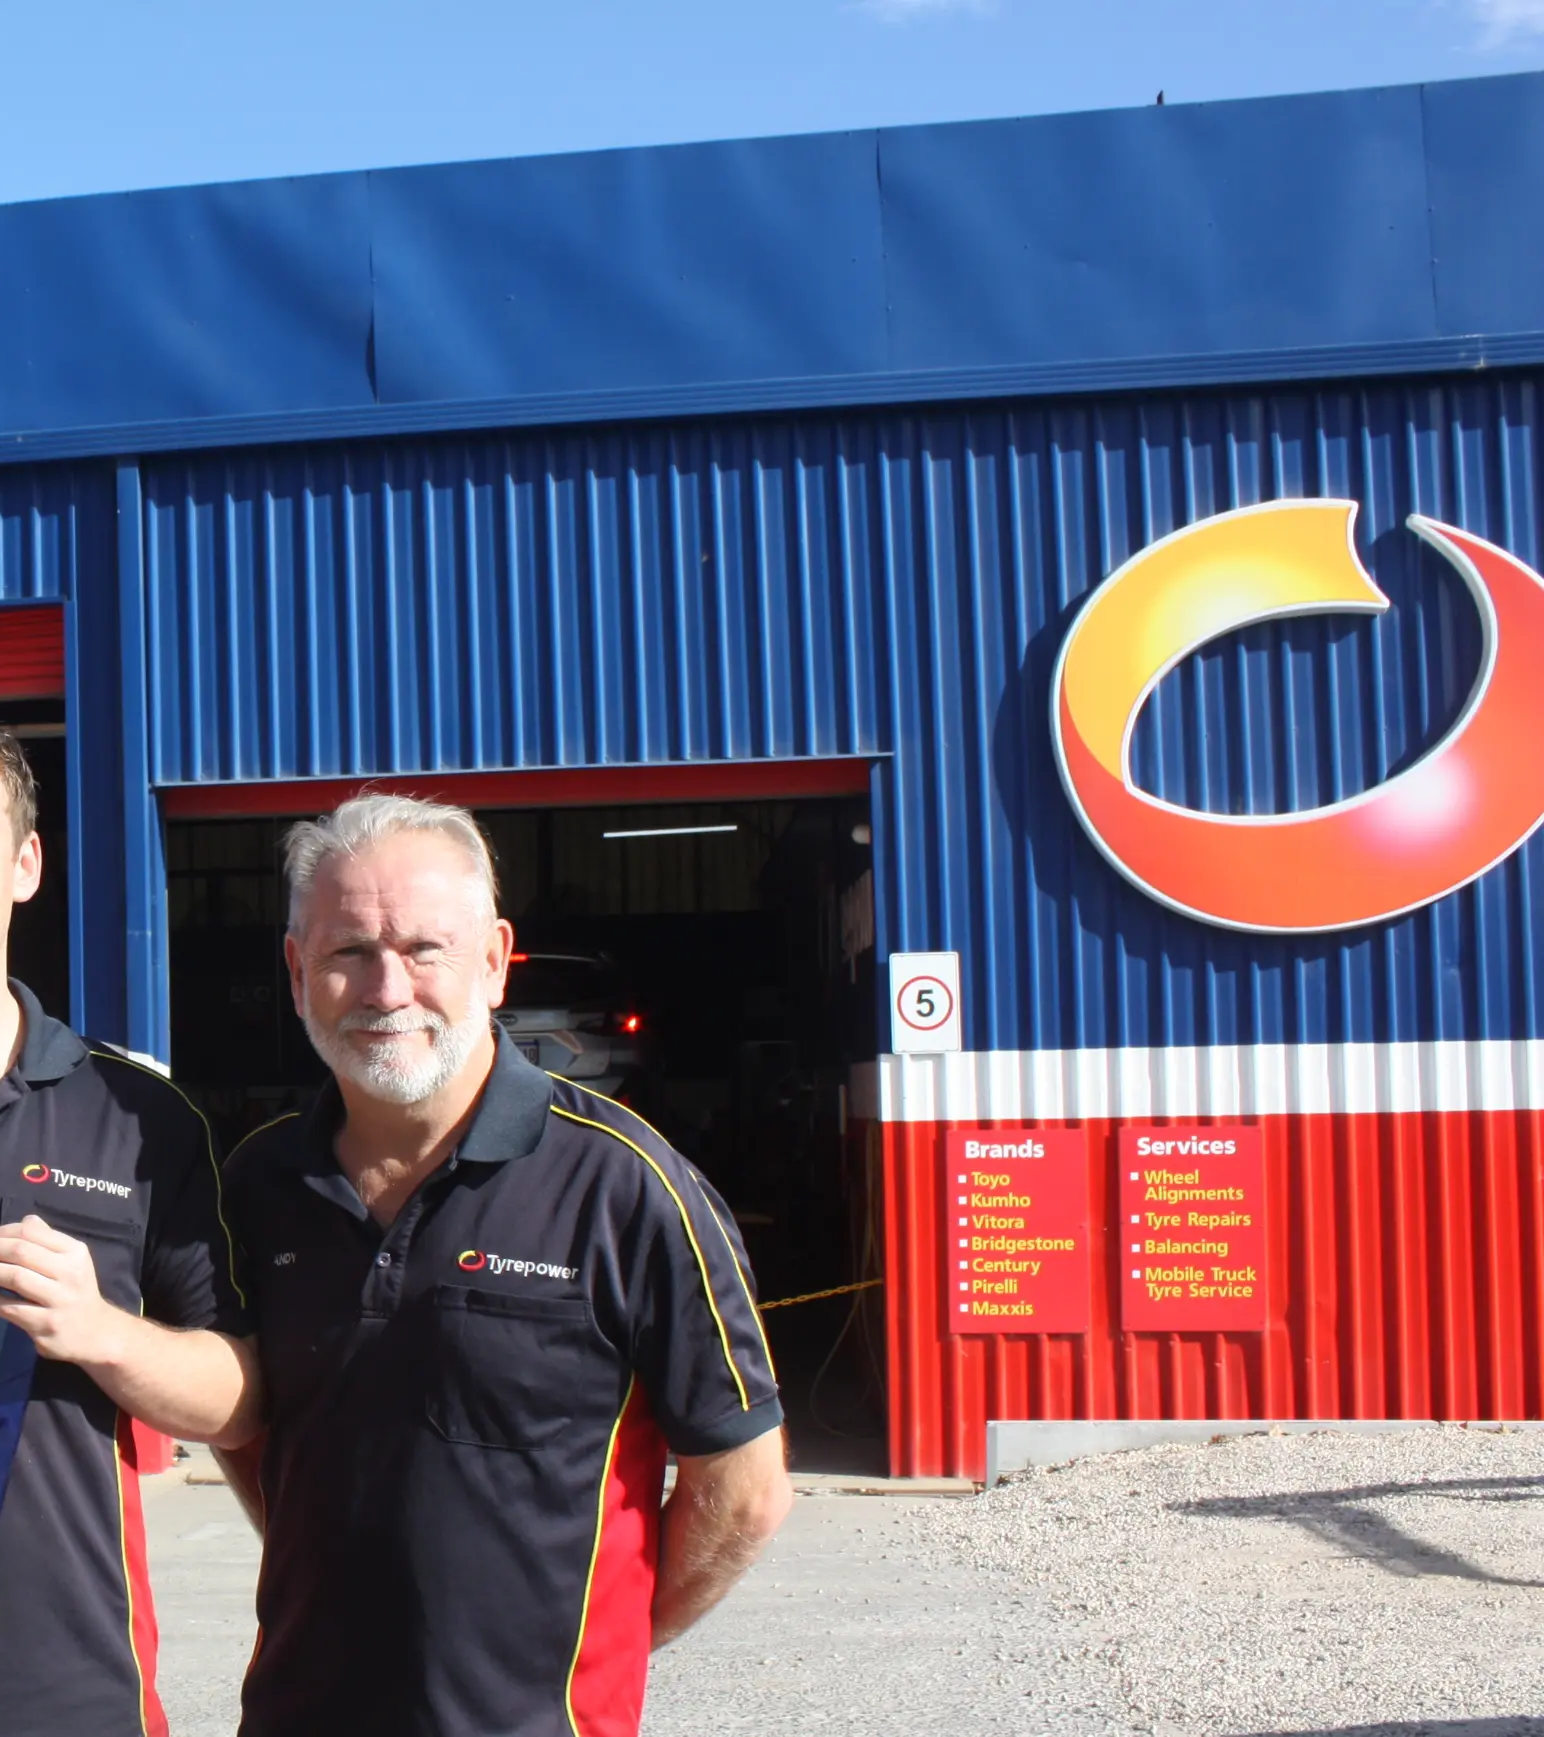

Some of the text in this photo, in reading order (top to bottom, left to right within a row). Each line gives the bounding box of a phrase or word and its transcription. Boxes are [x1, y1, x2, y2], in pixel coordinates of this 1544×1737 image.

[916, 989, 935, 1018] 5
[965, 1139, 1045, 1159] Brands
[1137, 1136, 1237, 1156] Services
[50, 1168, 132, 1199] Tyrepower
[971, 1171, 1011, 1189] Toyo
[1144, 1169, 1200, 1185] Wheel
[971, 1192, 1031, 1208] Kumho
[1144, 1186, 1244, 1205] Alignments
[972, 1214, 1025, 1230] Vitora
[1144, 1211, 1252, 1231] Tyre Repairs
[971, 1236, 1075, 1255] Bridgestone
[1144, 1238, 1229, 1258] Balancing
[486, 1253, 578, 1280] Tyrepower
[972, 1257, 1041, 1276] Century
[1144, 1266, 1257, 1282] Mobile Truck
[972, 1278, 1018, 1294] Pirelli
[1146, 1281, 1253, 1302] Tyre Service
[972, 1300, 1034, 1316] Maxxis
